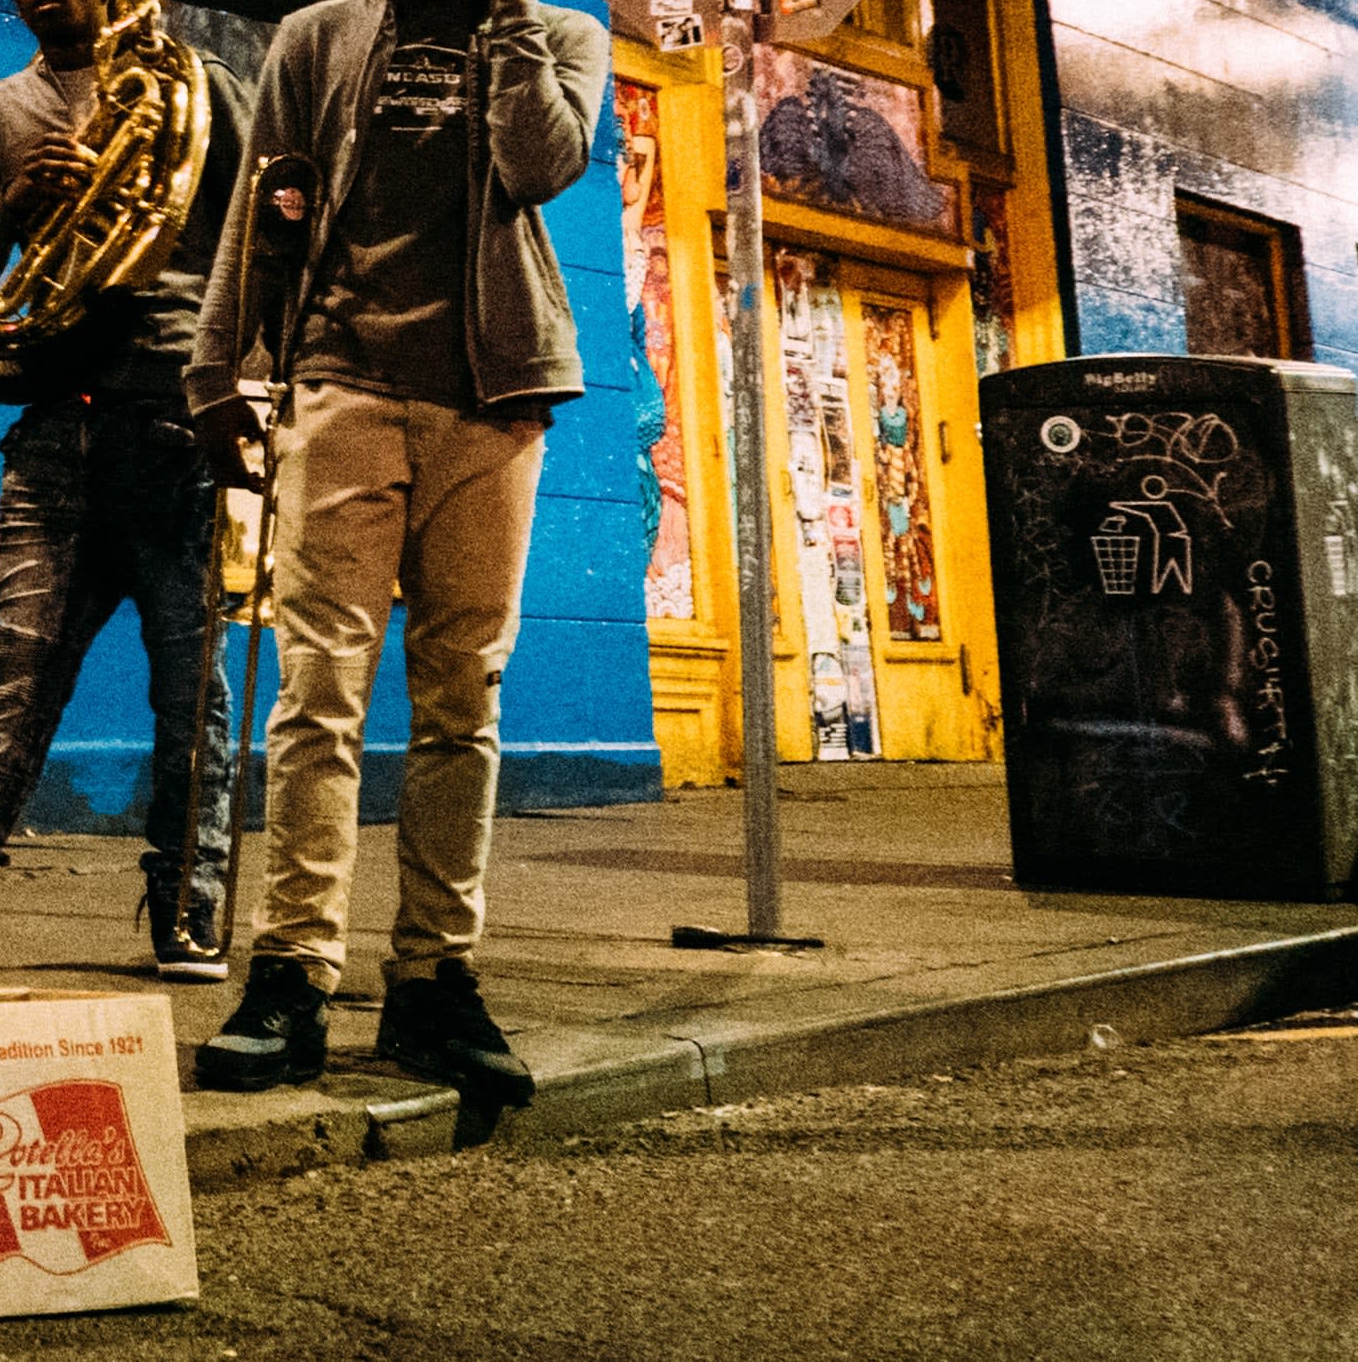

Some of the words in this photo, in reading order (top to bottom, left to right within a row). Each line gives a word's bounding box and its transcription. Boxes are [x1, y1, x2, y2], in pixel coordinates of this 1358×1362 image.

[58, 1037, 104, 1058] Since
[108, 1035, 144, 1055] 1921
[17, 1165, 136, 1201] ITALIAN
[19, 1196, 149, 1232] BAKERY
